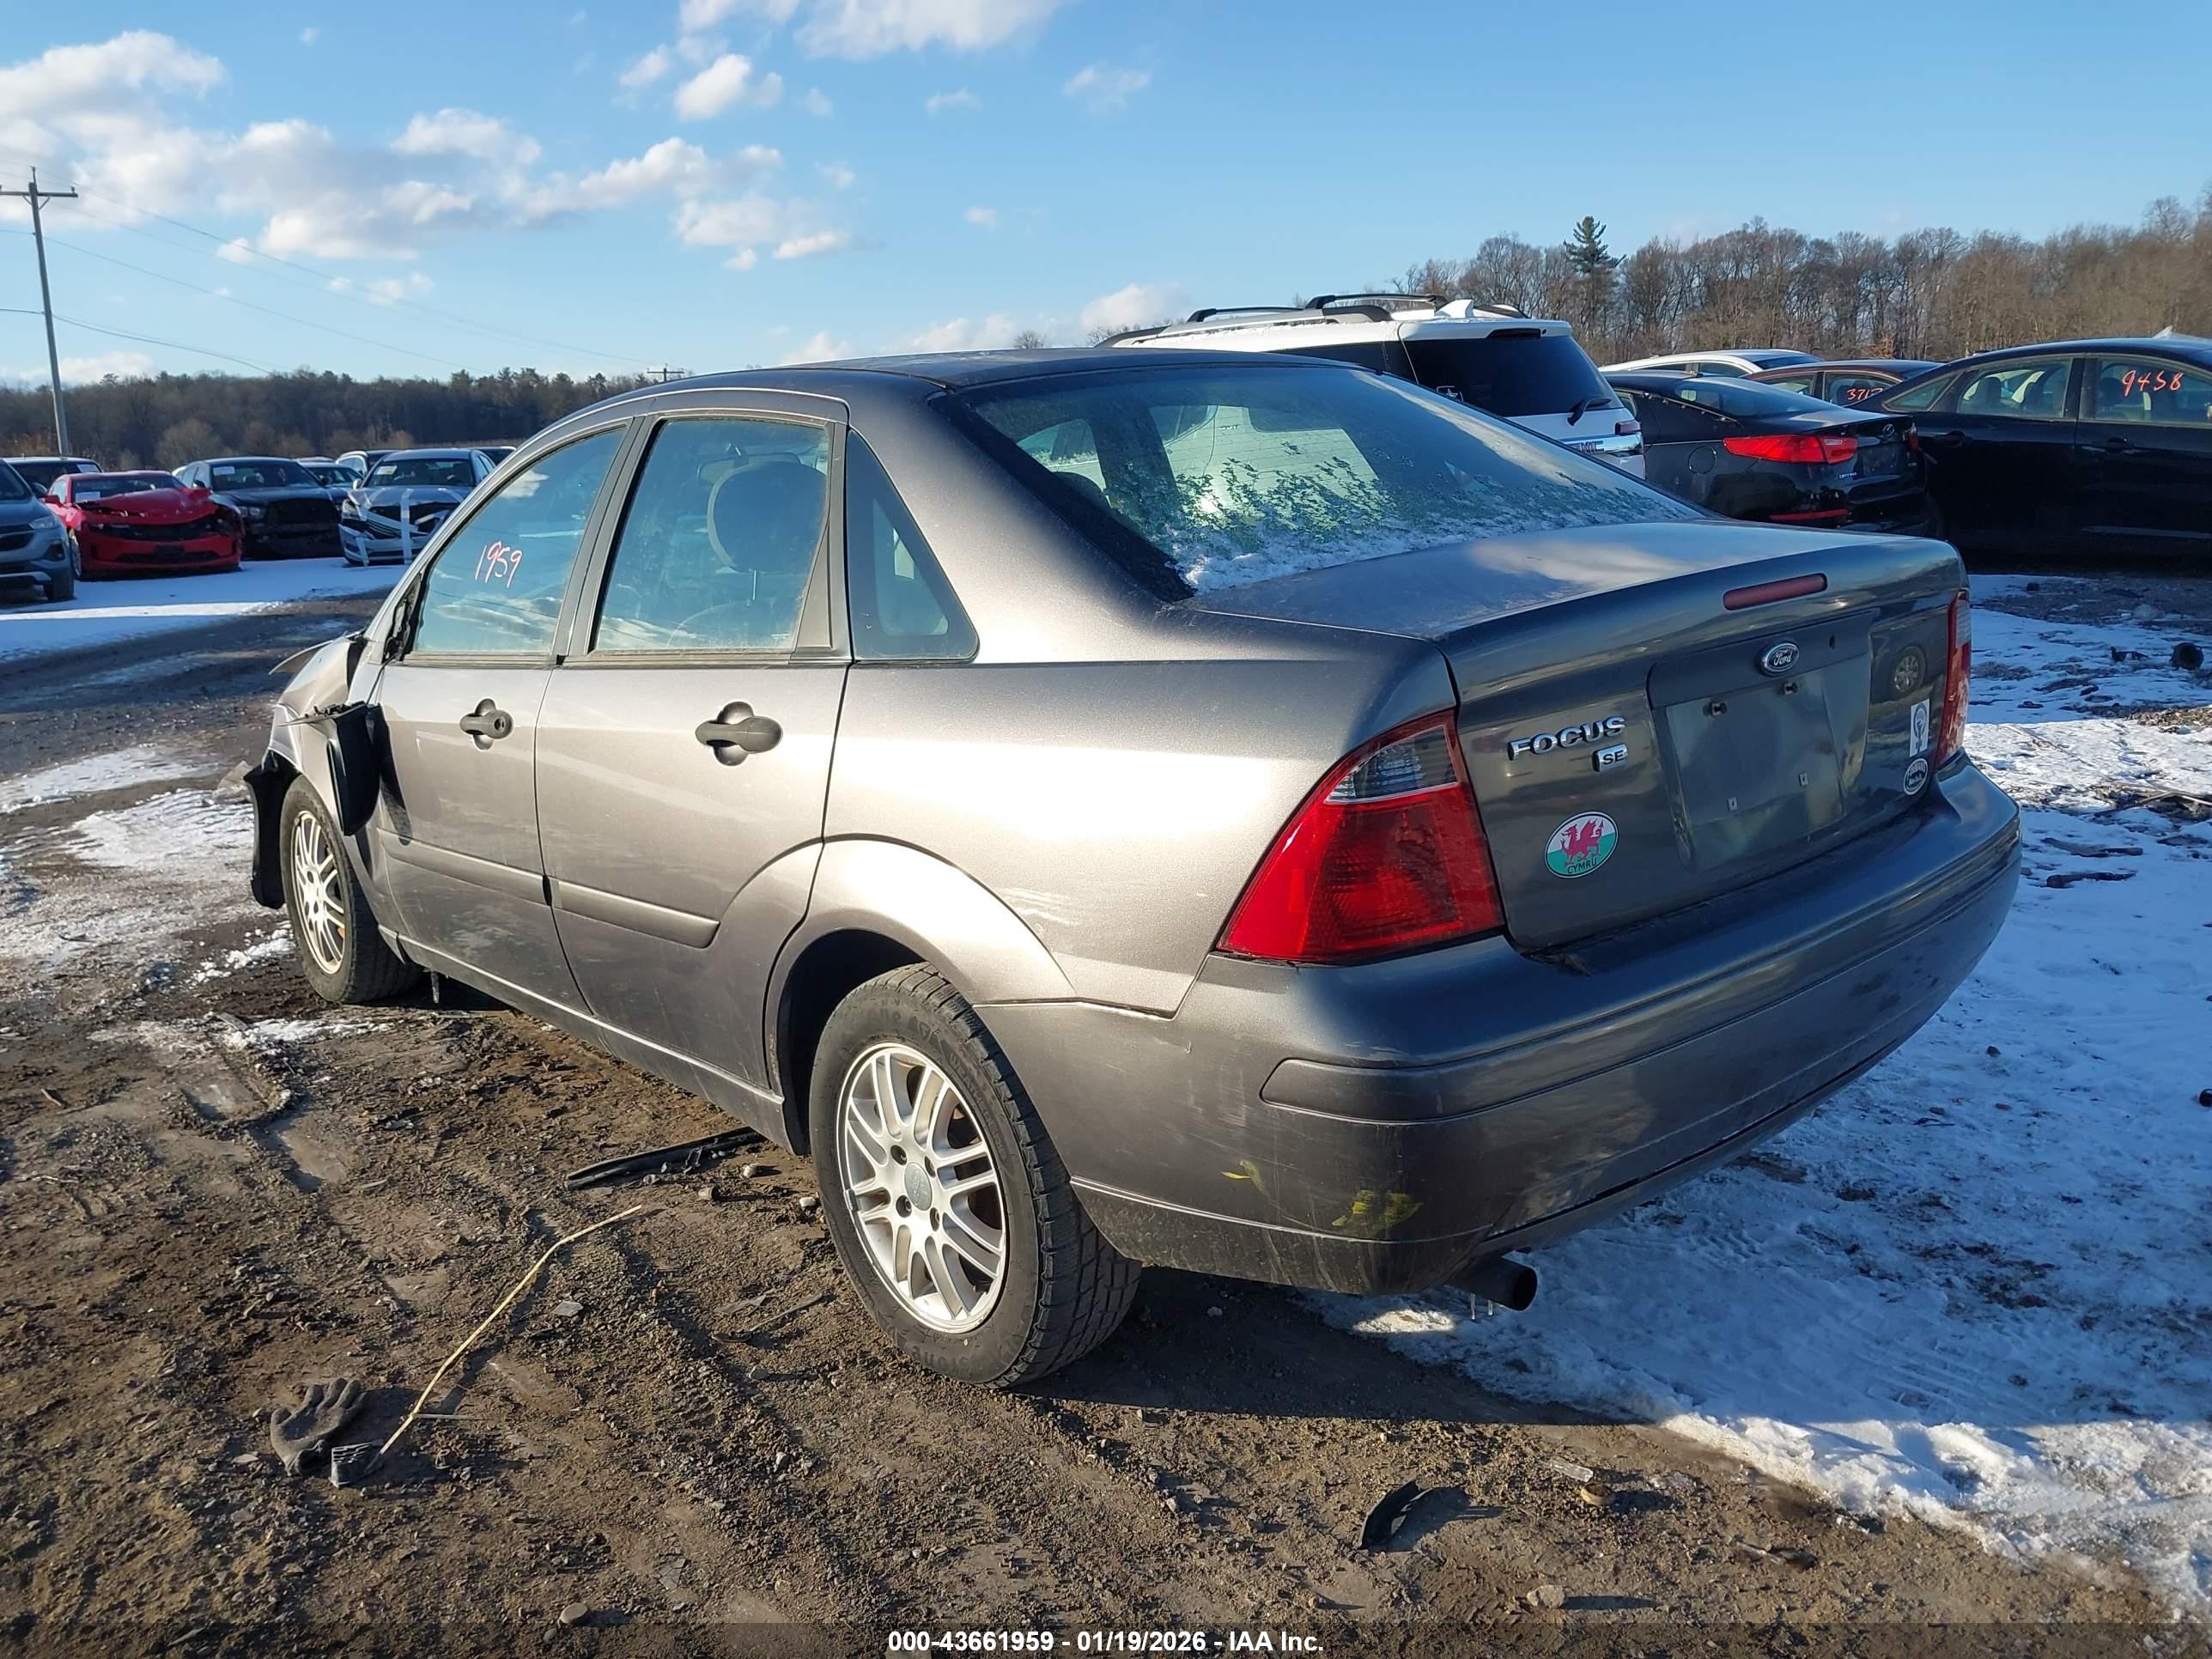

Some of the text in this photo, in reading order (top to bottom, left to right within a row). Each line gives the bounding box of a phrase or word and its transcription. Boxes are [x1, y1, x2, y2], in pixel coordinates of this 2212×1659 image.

[2122, 370, 2185, 397] 9458
[474, 540, 523, 589] 1959
[1773, 649, 1794, 666] Ford
[1507, 716, 1626, 762] FOCUS
[1602, 750, 1625, 766] SE
[1566, 857, 1598, 875] CYMRU
